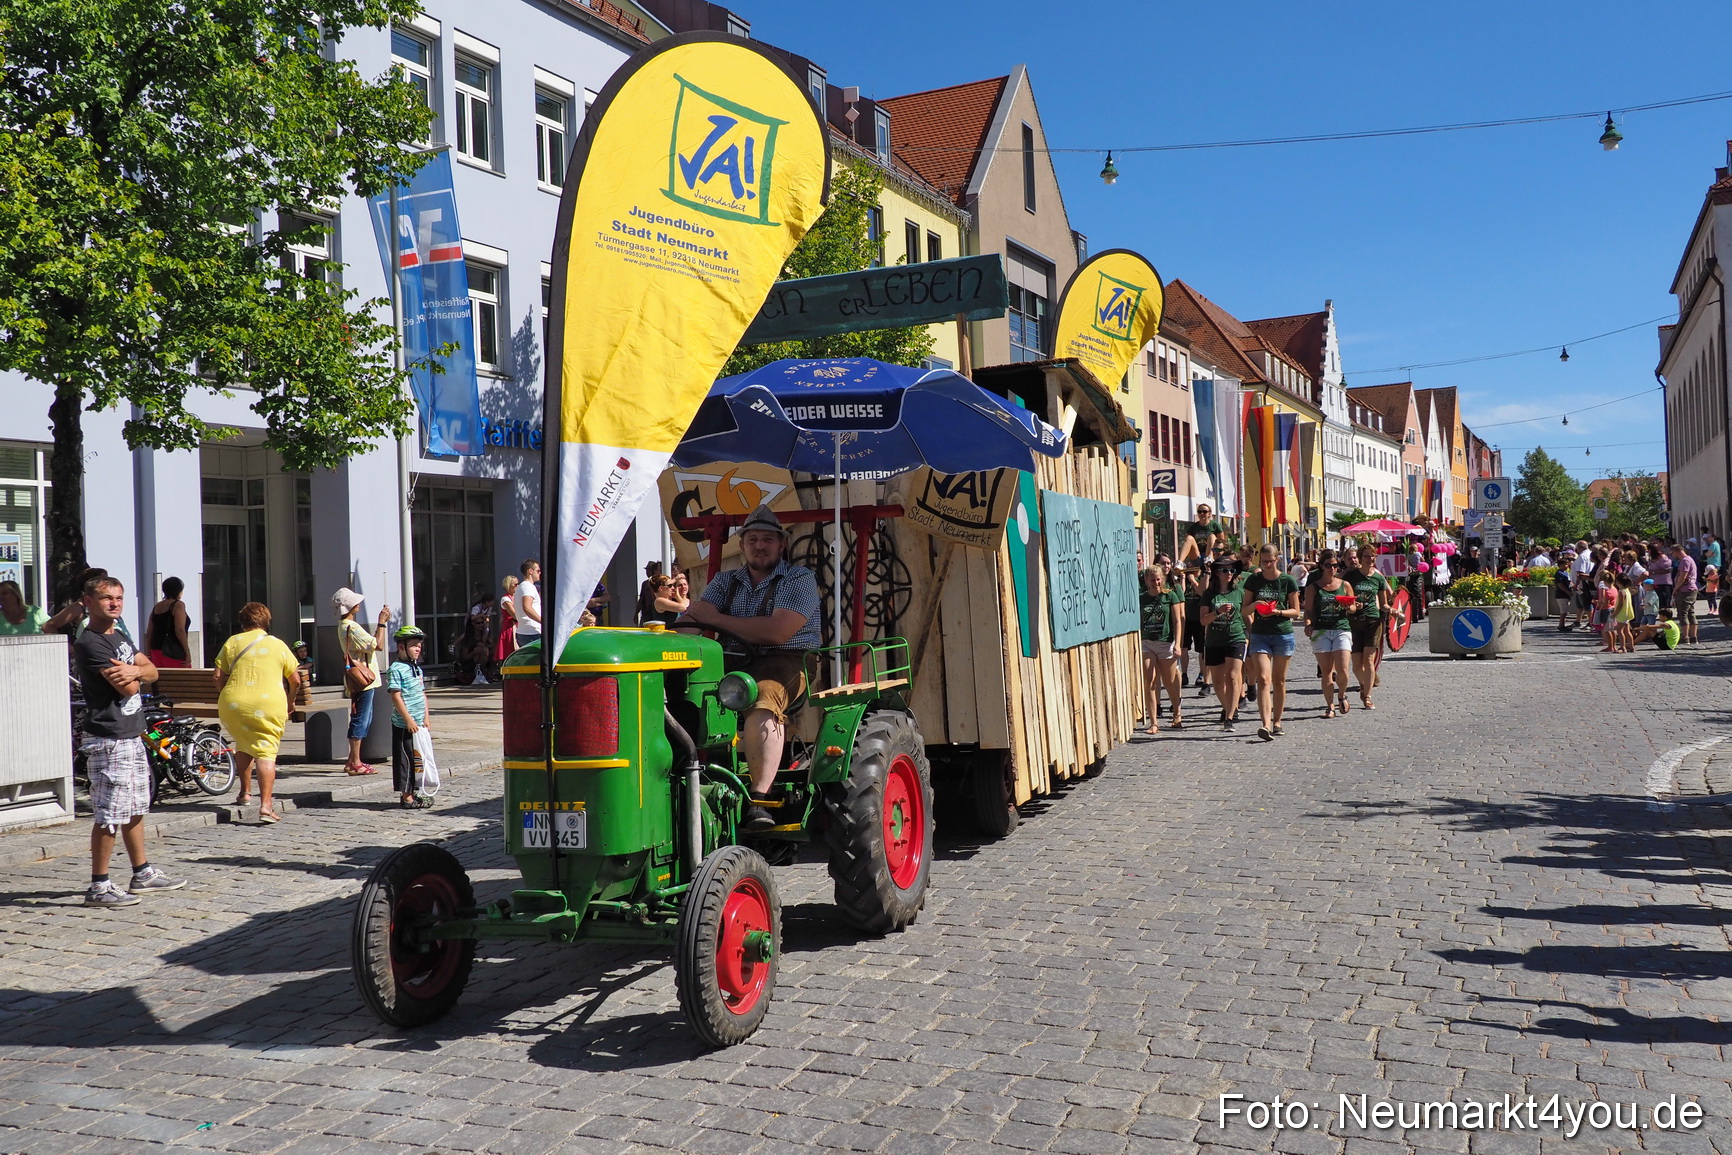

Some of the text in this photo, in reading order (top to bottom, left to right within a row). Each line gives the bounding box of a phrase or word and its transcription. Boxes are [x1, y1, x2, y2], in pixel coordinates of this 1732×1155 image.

[678, 115, 756, 200] JA!
[694, 189, 746, 212] Jugendarbeit
[628, 205, 715, 238] Jugendbüro
[594, 241, 605, 249] Tel.
[597, 231, 740, 276] Türmergasse 11, 92318 Neumarkt
[611, 219, 729, 261] Stadt Neumarkt
[762, 287, 807, 320] EN
[785, 404, 827, 421] EIDER
[829, 404, 884, 419] WEISSE
[480, 416, 543, 450] Raiffe
[572, 469, 623, 547] NEUMARKT
[933, 497, 984, 523] Jugendbüro
[907, 506, 992, 546] Stadt Neumarkt
[1055, 519, 1084, 558] SOMMER
[1057, 557, 1086, 596] FERIEN
[1061, 589, 1088, 632] SPIELE
[662, 651, 688, 661] DEUTZ
[519, 801, 586, 811] DEUTZ
